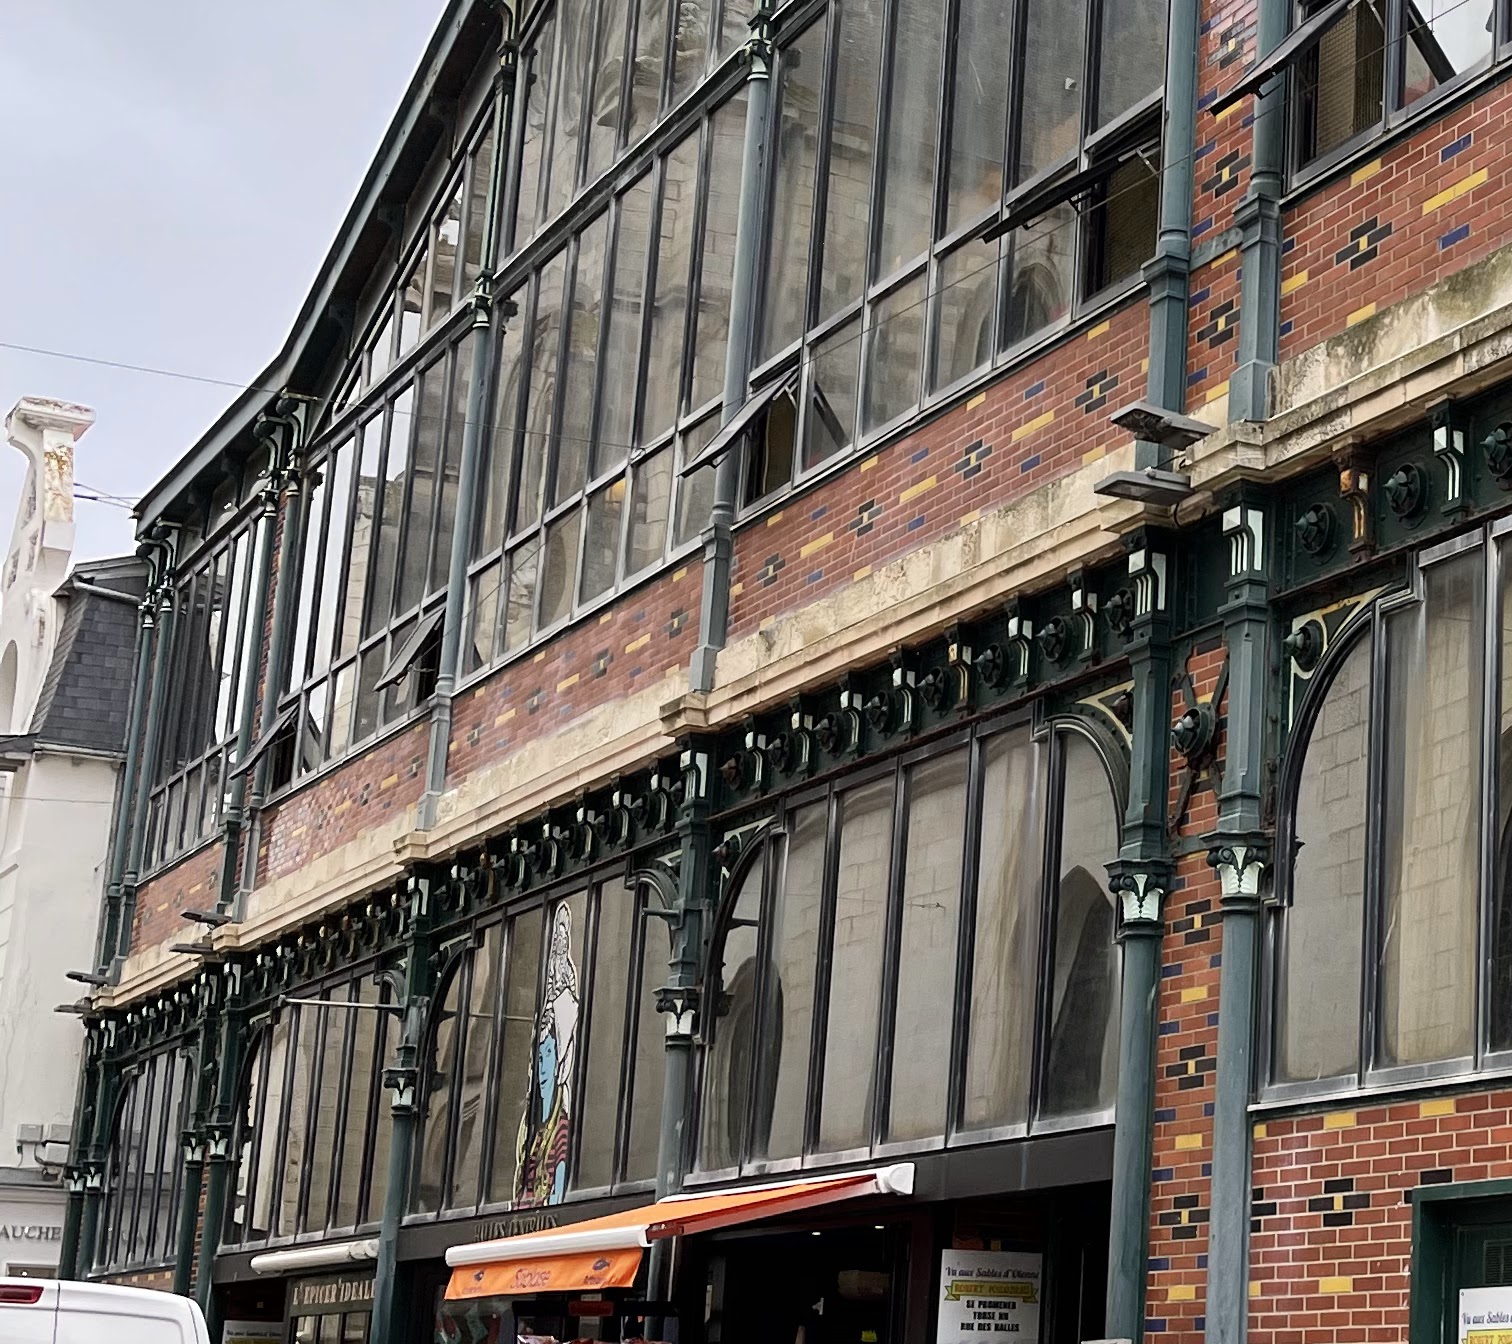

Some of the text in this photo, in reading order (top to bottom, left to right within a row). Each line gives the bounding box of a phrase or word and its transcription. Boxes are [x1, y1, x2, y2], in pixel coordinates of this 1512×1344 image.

[0, 1224, 61, 1241] AUCHE
[966, 1300, 1016, 1309] SE PROMENER
[973, 1311, 996, 1320] TORSE
[1487, 1311, 1510, 1324] Sables
[960, 1322, 1019, 1332] RUE DES HALLES
